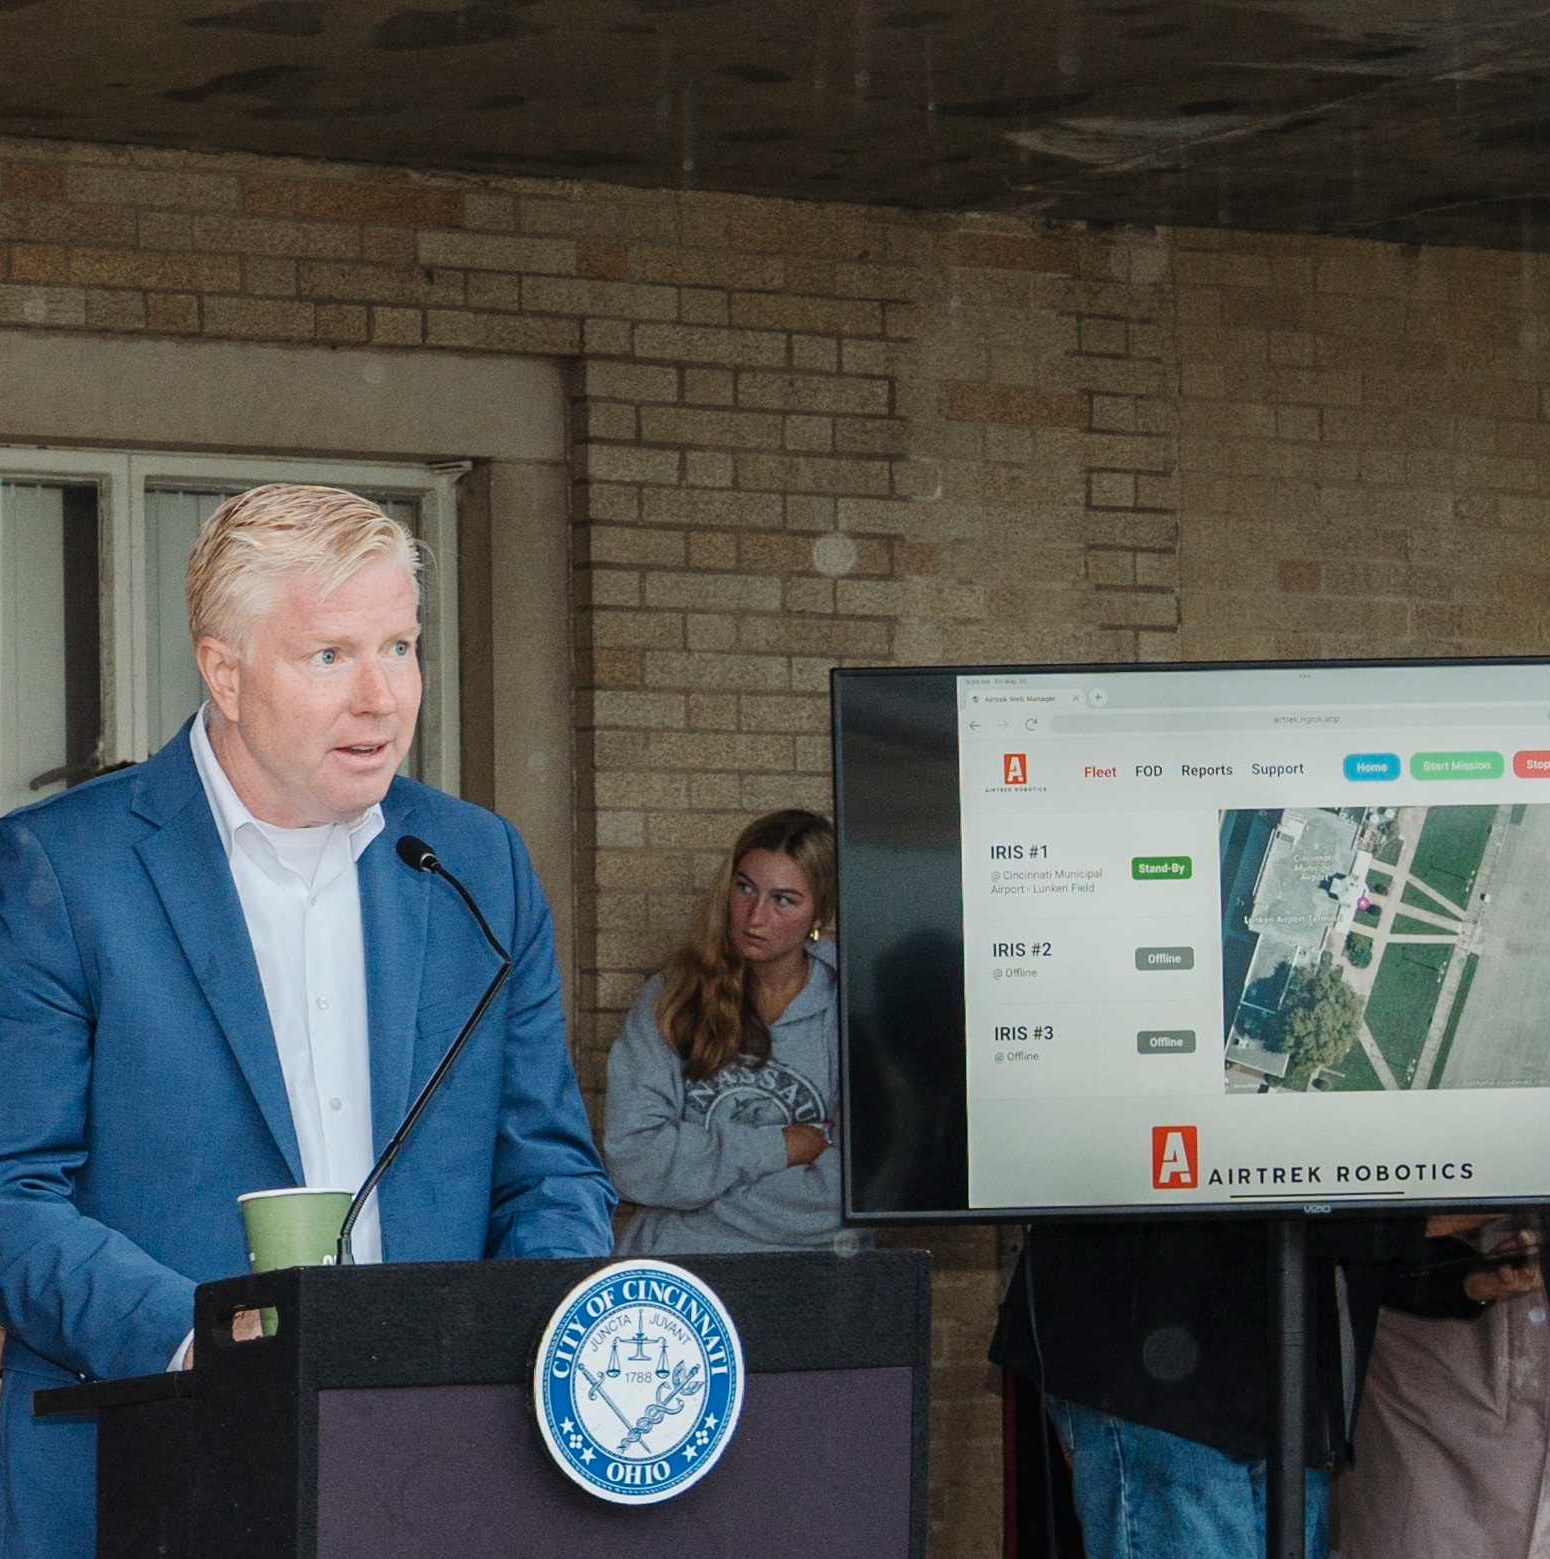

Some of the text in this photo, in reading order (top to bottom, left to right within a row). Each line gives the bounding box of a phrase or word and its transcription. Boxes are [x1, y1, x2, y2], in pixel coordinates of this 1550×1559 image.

[1084, 763, 1304, 778] Fleet FOD Reports Support
[1356, 762, 1388, 773] Home
[1423, 760, 1491, 772] Start Mission
[1526, 759, 1550, 771] Stop
[990, 845, 1048, 860] IRIS #1
[1002, 869, 1052, 881] Cincinnati
[1054, 868, 1103, 880] Municipal
[1138, 862, 1186, 875] Stand-By
[990, 884, 1025, 896] Airport
[1033, 883, 1068, 894] Lunken
[1071, 883, 1095, 893] Field
[1277, 915, 1306, 924] Airport
[992, 942, 1052, 957] IRIS #2
[1147, 953, 1182, 964] Offline
[1005, 967, 1038, 978] Offline
[994, 1025, 1054, 1041] IRIS #3
[1149, 1036, 1184, 1048] Offline
[1006, 1050, 1039, 1062] Offline
[687, 1065, 818, 1122] NASSAU
[1208, 1166, 1322, 1186] AIRTREK
[1336, 1162, 1474, 1183] ROBOTICS
[1303, 1205, 1332, 1214] VIZIO
[552, 1279, 729, 1379] CITY OF CINCINNATI
[591, 1313, 692, 1352] JUNCTA JUVANT
[624, 1371, 653, 1384] 1788
[606, 1460, 672, 1485] OHIO
